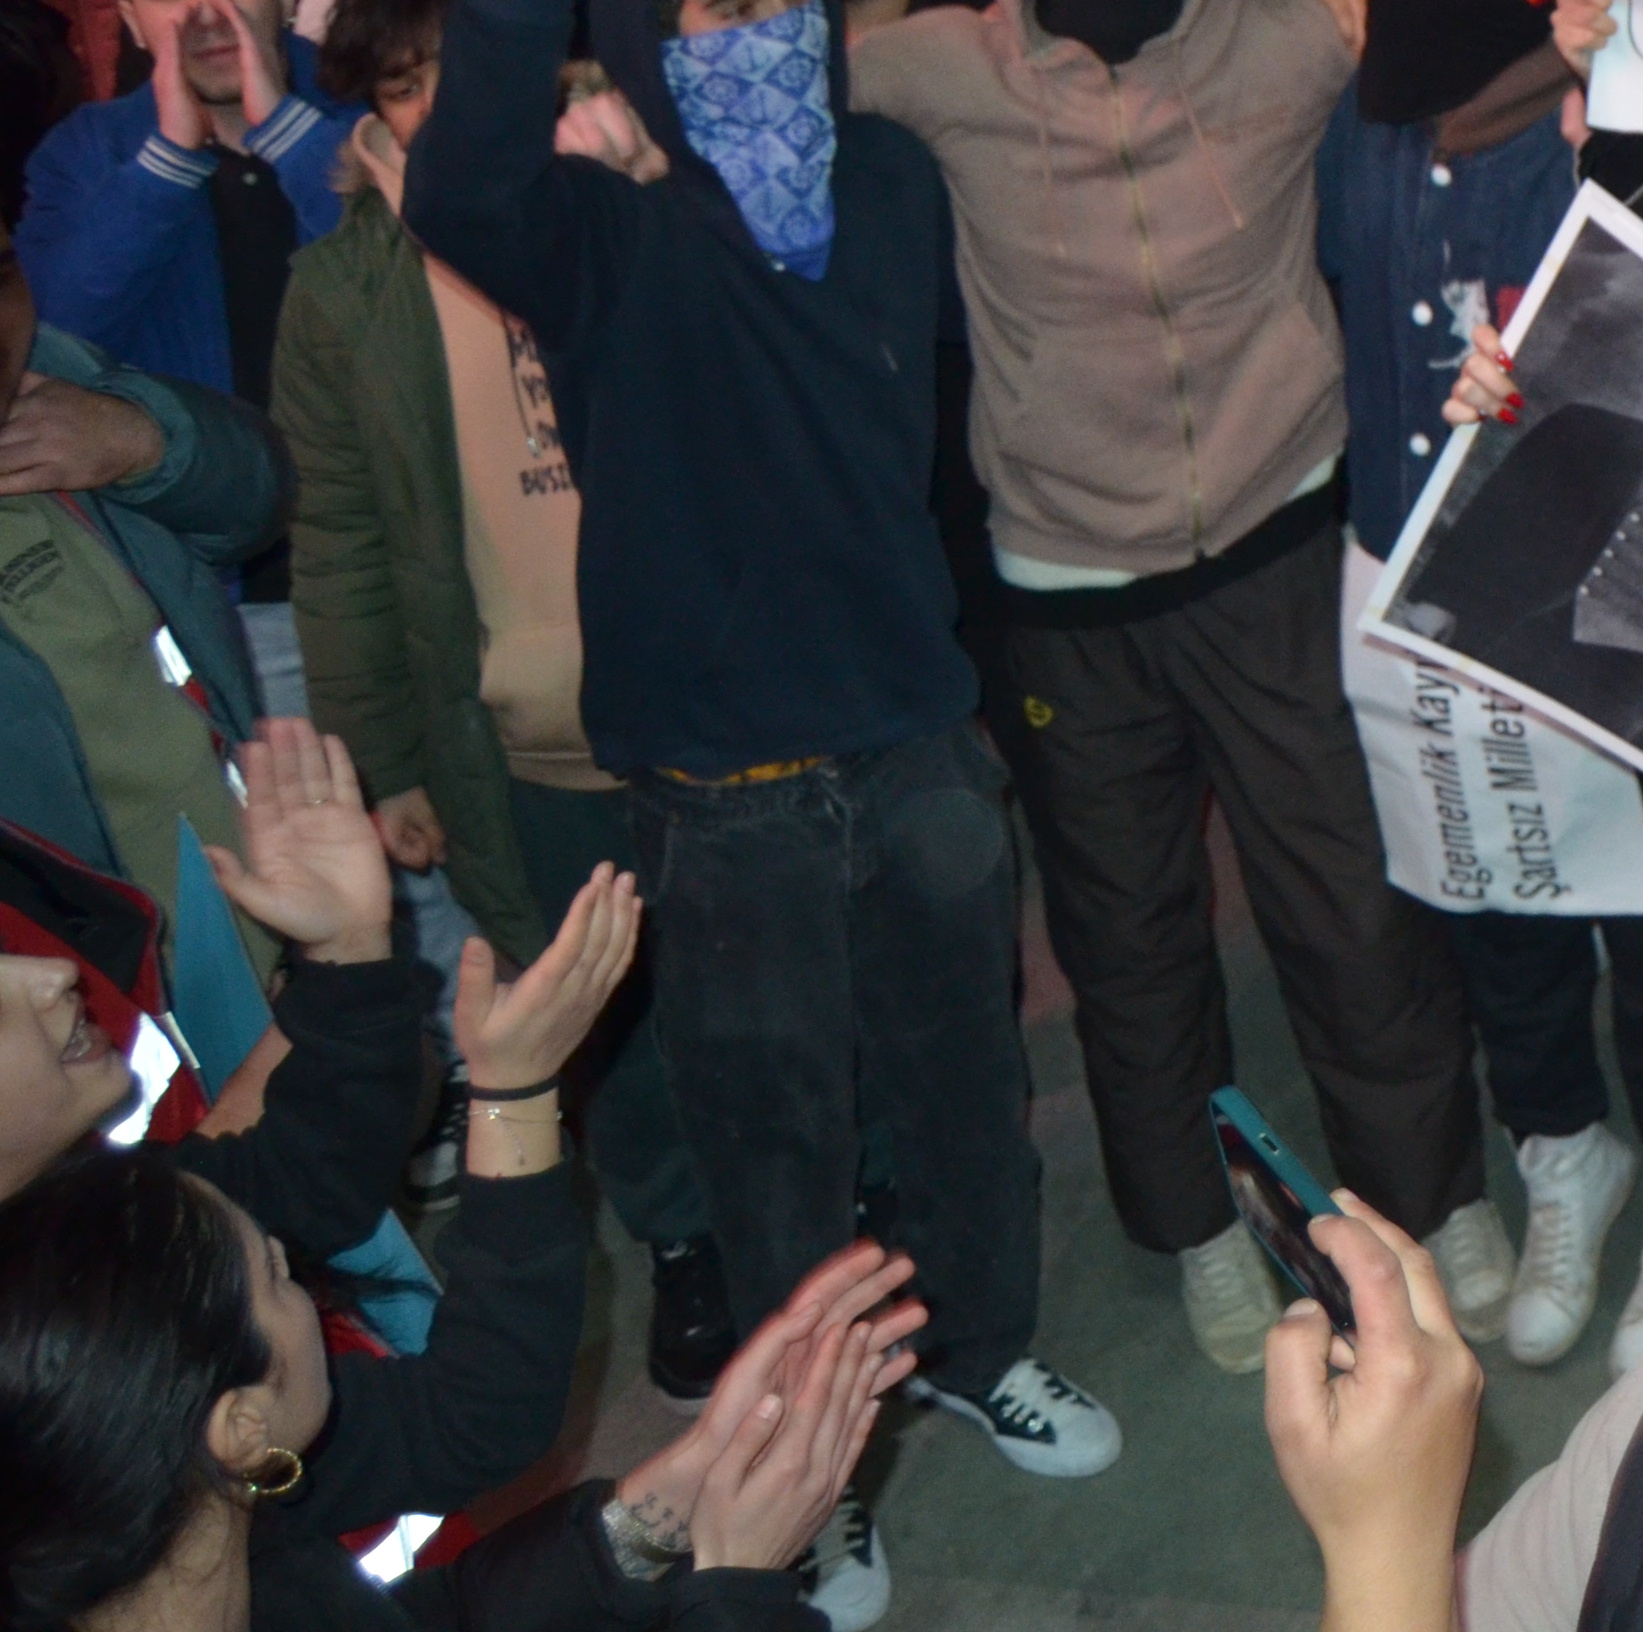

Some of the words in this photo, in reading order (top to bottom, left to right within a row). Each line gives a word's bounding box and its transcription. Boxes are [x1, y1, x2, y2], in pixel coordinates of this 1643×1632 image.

[519, 461, 575, 497] BUSI
[1420, 744, 1494, 900] Egemenlik
[1505, 801, 1573, 901] Şartsız
